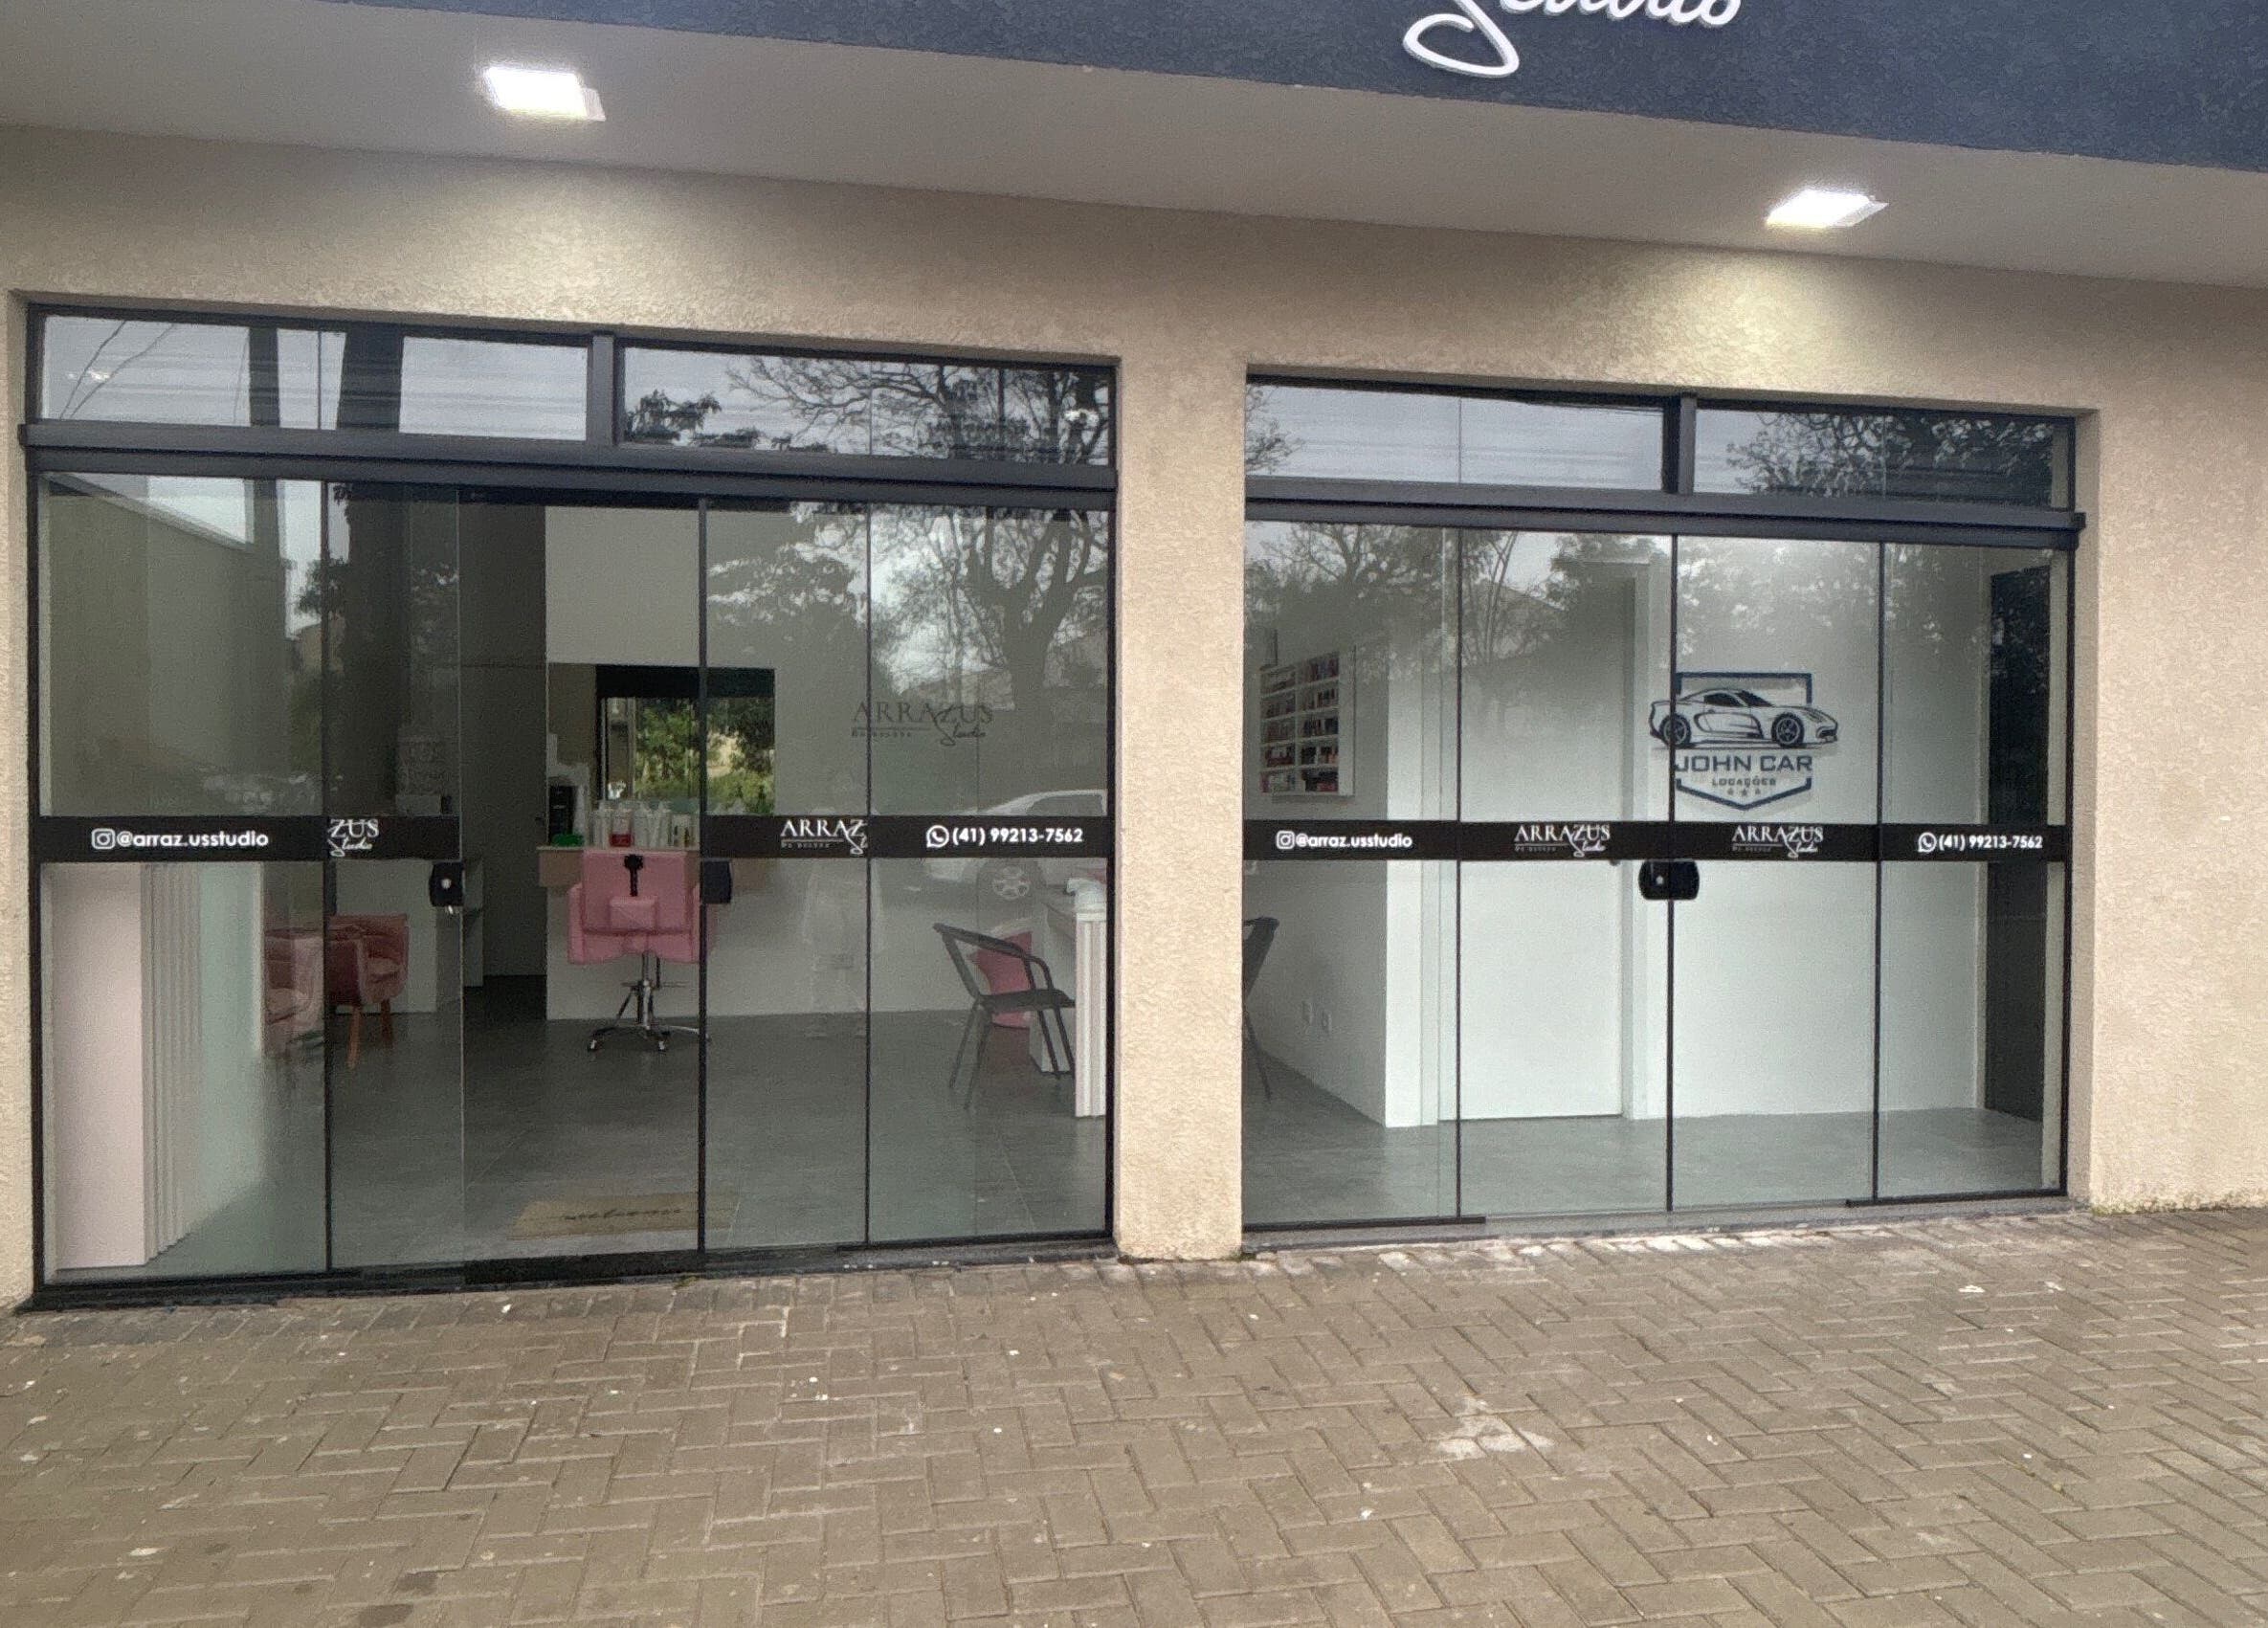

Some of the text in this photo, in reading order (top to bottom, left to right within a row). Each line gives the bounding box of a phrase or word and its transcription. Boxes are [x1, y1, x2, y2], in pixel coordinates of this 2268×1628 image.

[1675, 754, 1813, 771] JOHN CAR
[116, 830, 270, 848] @arraz.usstudio
[952, 827, 1083, 846] (41) 99213-7562
[1295, 832, 1413, 848] @arraz.usstudio
[1513, 824, 1612, 842] ARRAZUS
[1731, 825, 1824, 843] ARRAZUS
[1938, 834, 2044, 852] (41) 99213-7562
